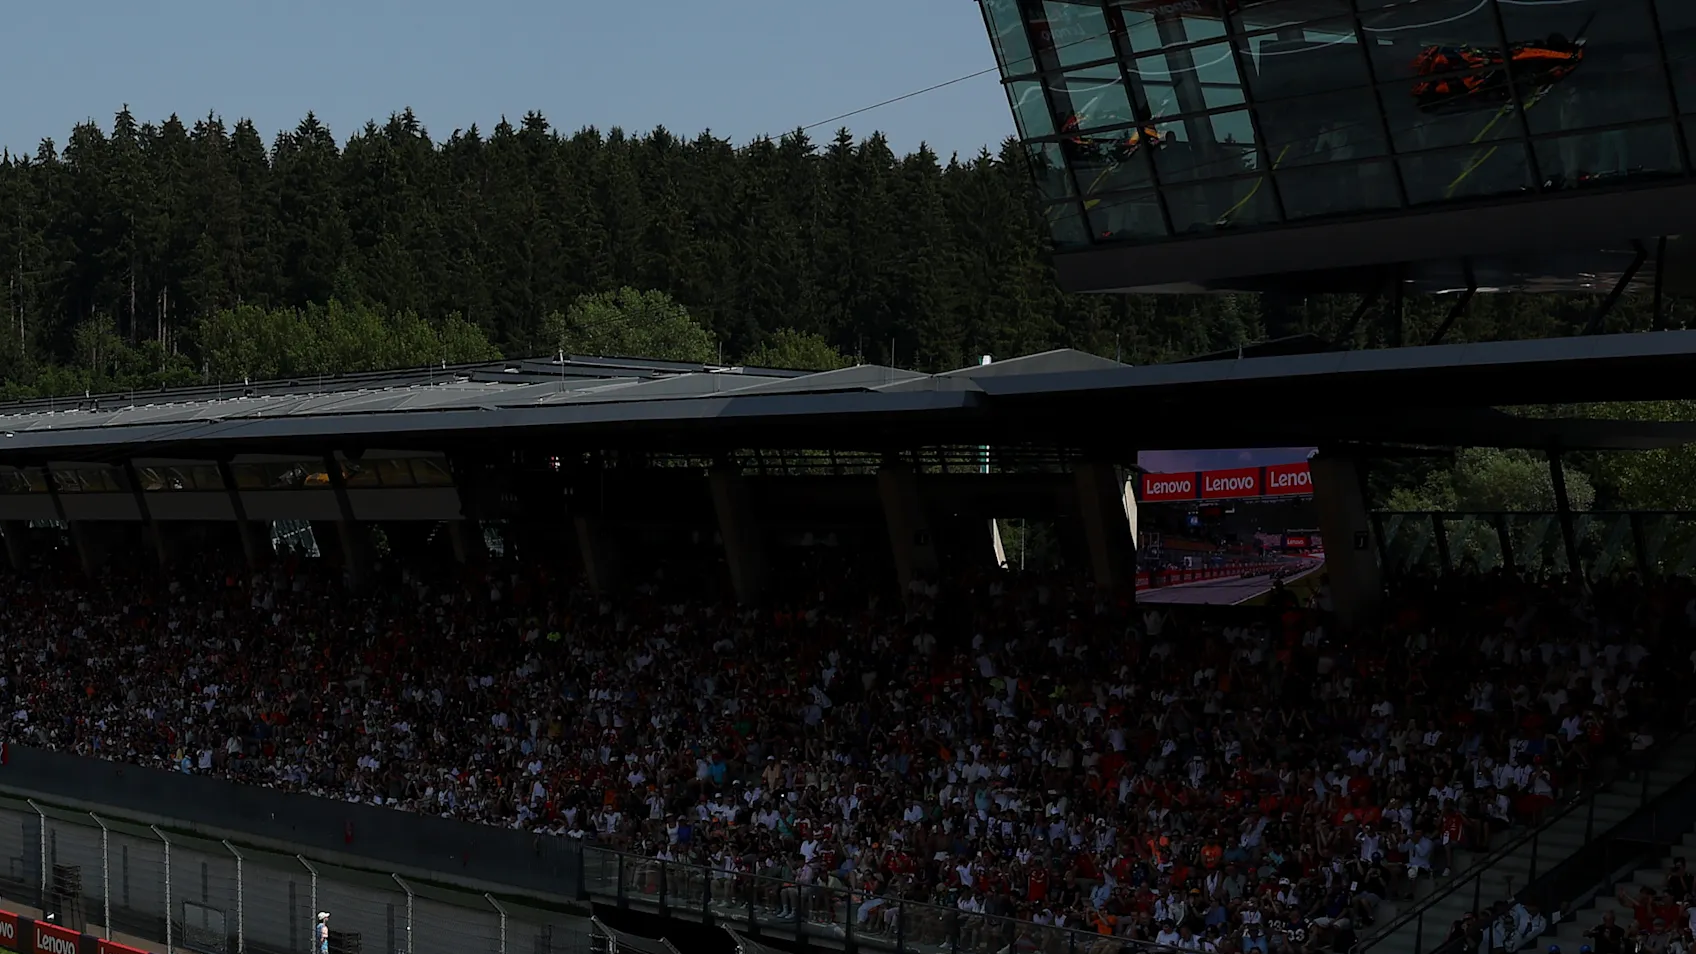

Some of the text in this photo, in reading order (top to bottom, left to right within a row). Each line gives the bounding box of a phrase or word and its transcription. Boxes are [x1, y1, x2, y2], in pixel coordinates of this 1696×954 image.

[1146, 480, 1191, 495] Lenovo
[1205, 475, 1254, 491] Lenovo
[1287, 929, 1305, 942] 33
